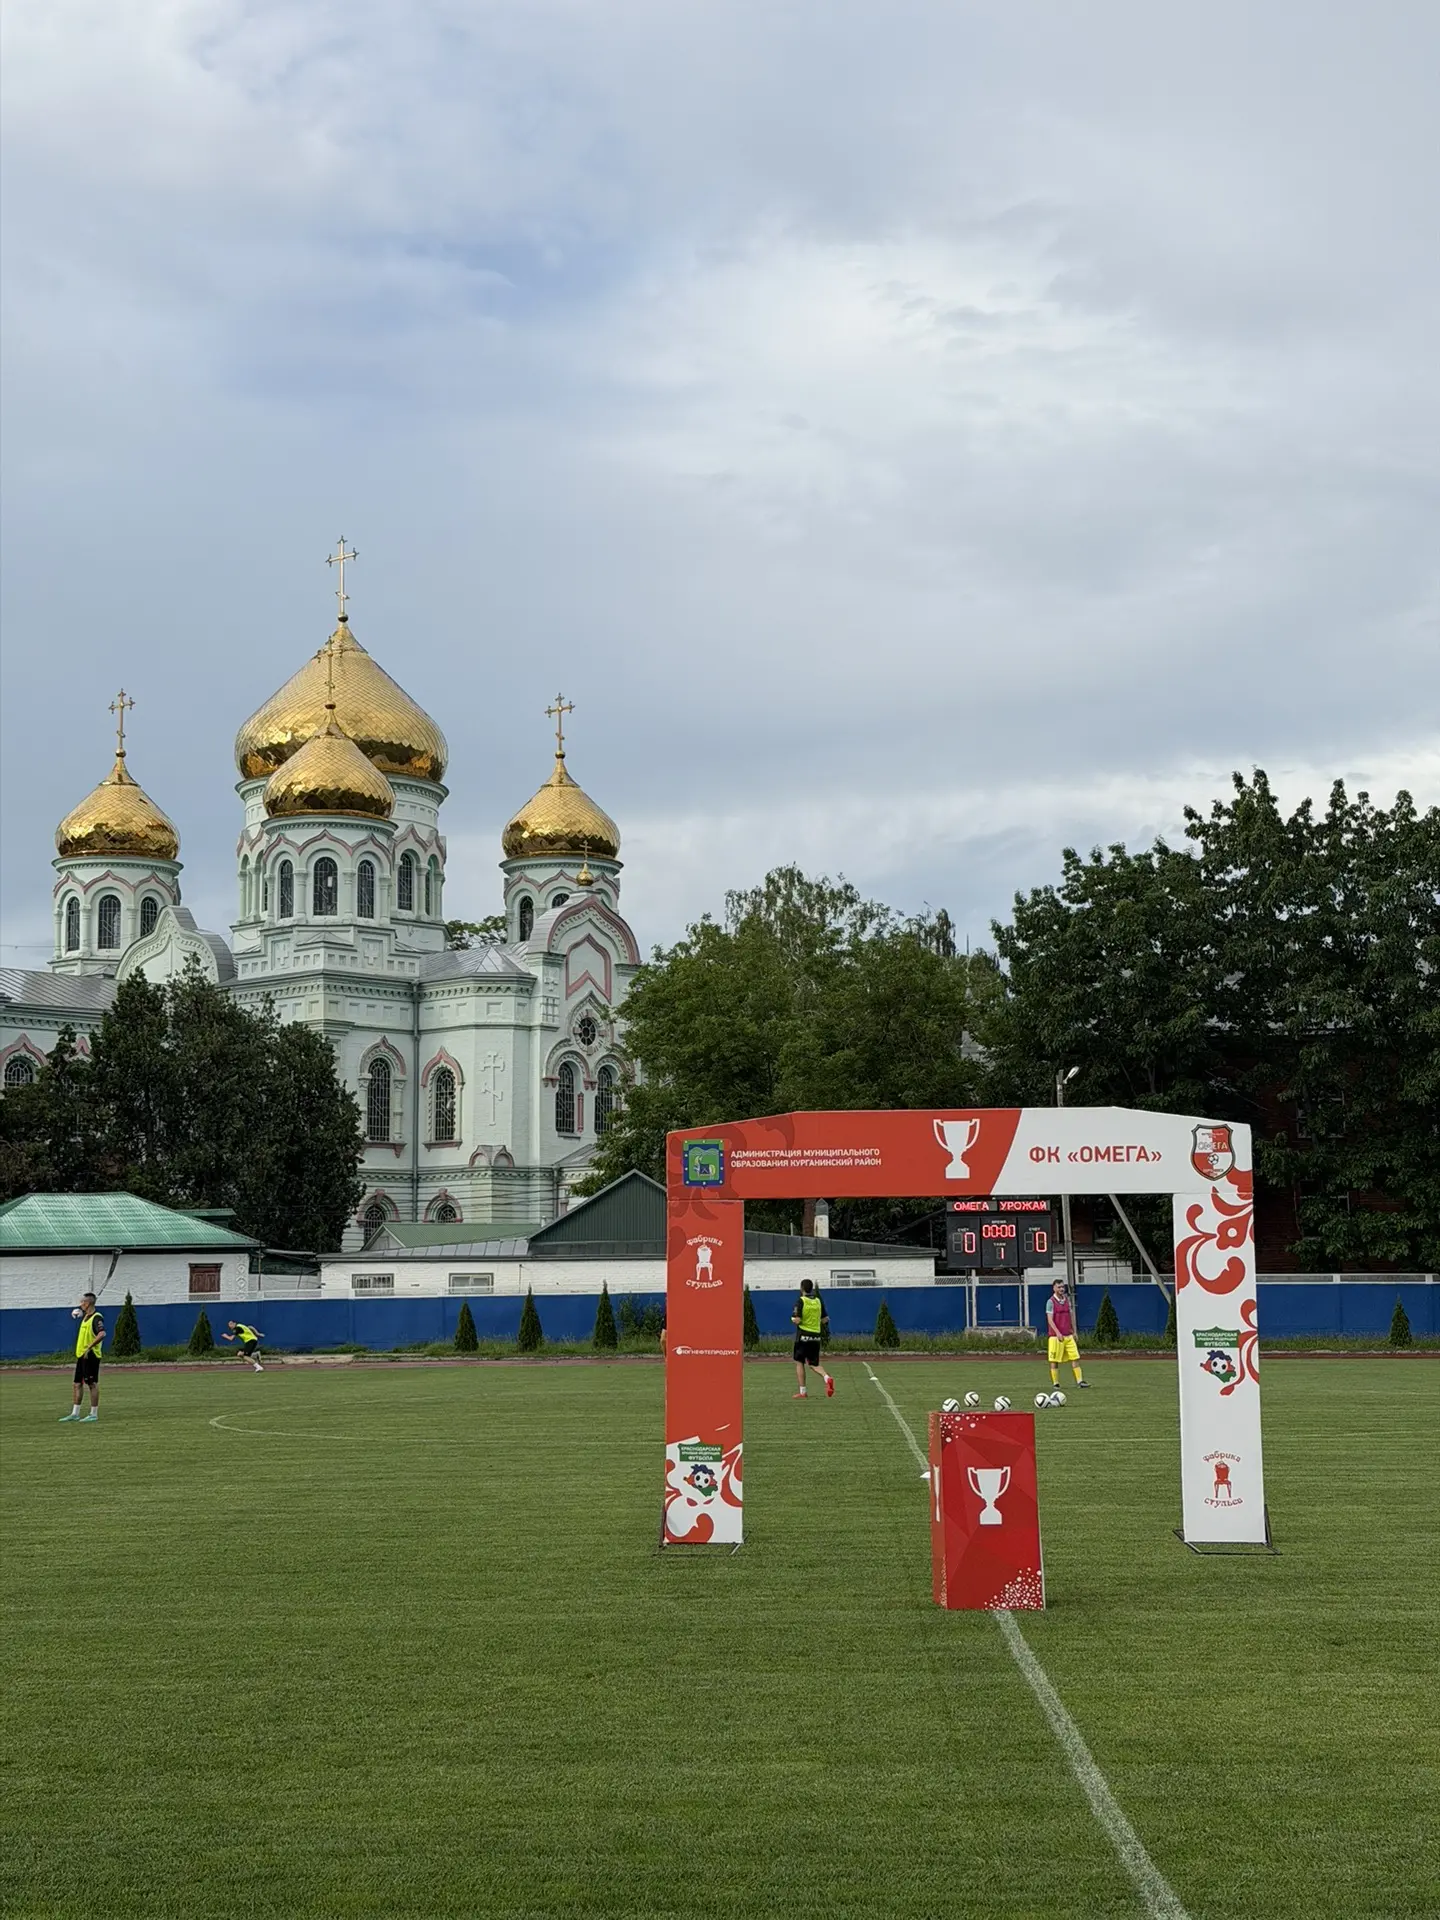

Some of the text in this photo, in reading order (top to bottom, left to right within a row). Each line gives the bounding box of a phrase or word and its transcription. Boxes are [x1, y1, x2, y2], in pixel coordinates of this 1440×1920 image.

[730, 1148, 880, 1159] АДМИНИСТРАЦИЯ МУНИЦИПАЛЬНОГО
[1029, 1145, 1162, 1163] ФК «ОМЕГА»
[730, 1156, 882, 1168] ОБРАЗОВАНИЯ КУРГАНИНСКИЙ РАЙОН
[953, 1201, 990, 1211] ОМЕГА
[1000, 1200, 1047, 1211] УРОЖАЙ
[982, 1224, 1016, 1238] 00:00
[964, 1232, 976, 1253] 0
[1035, 1231, 1047, 1253] 0
